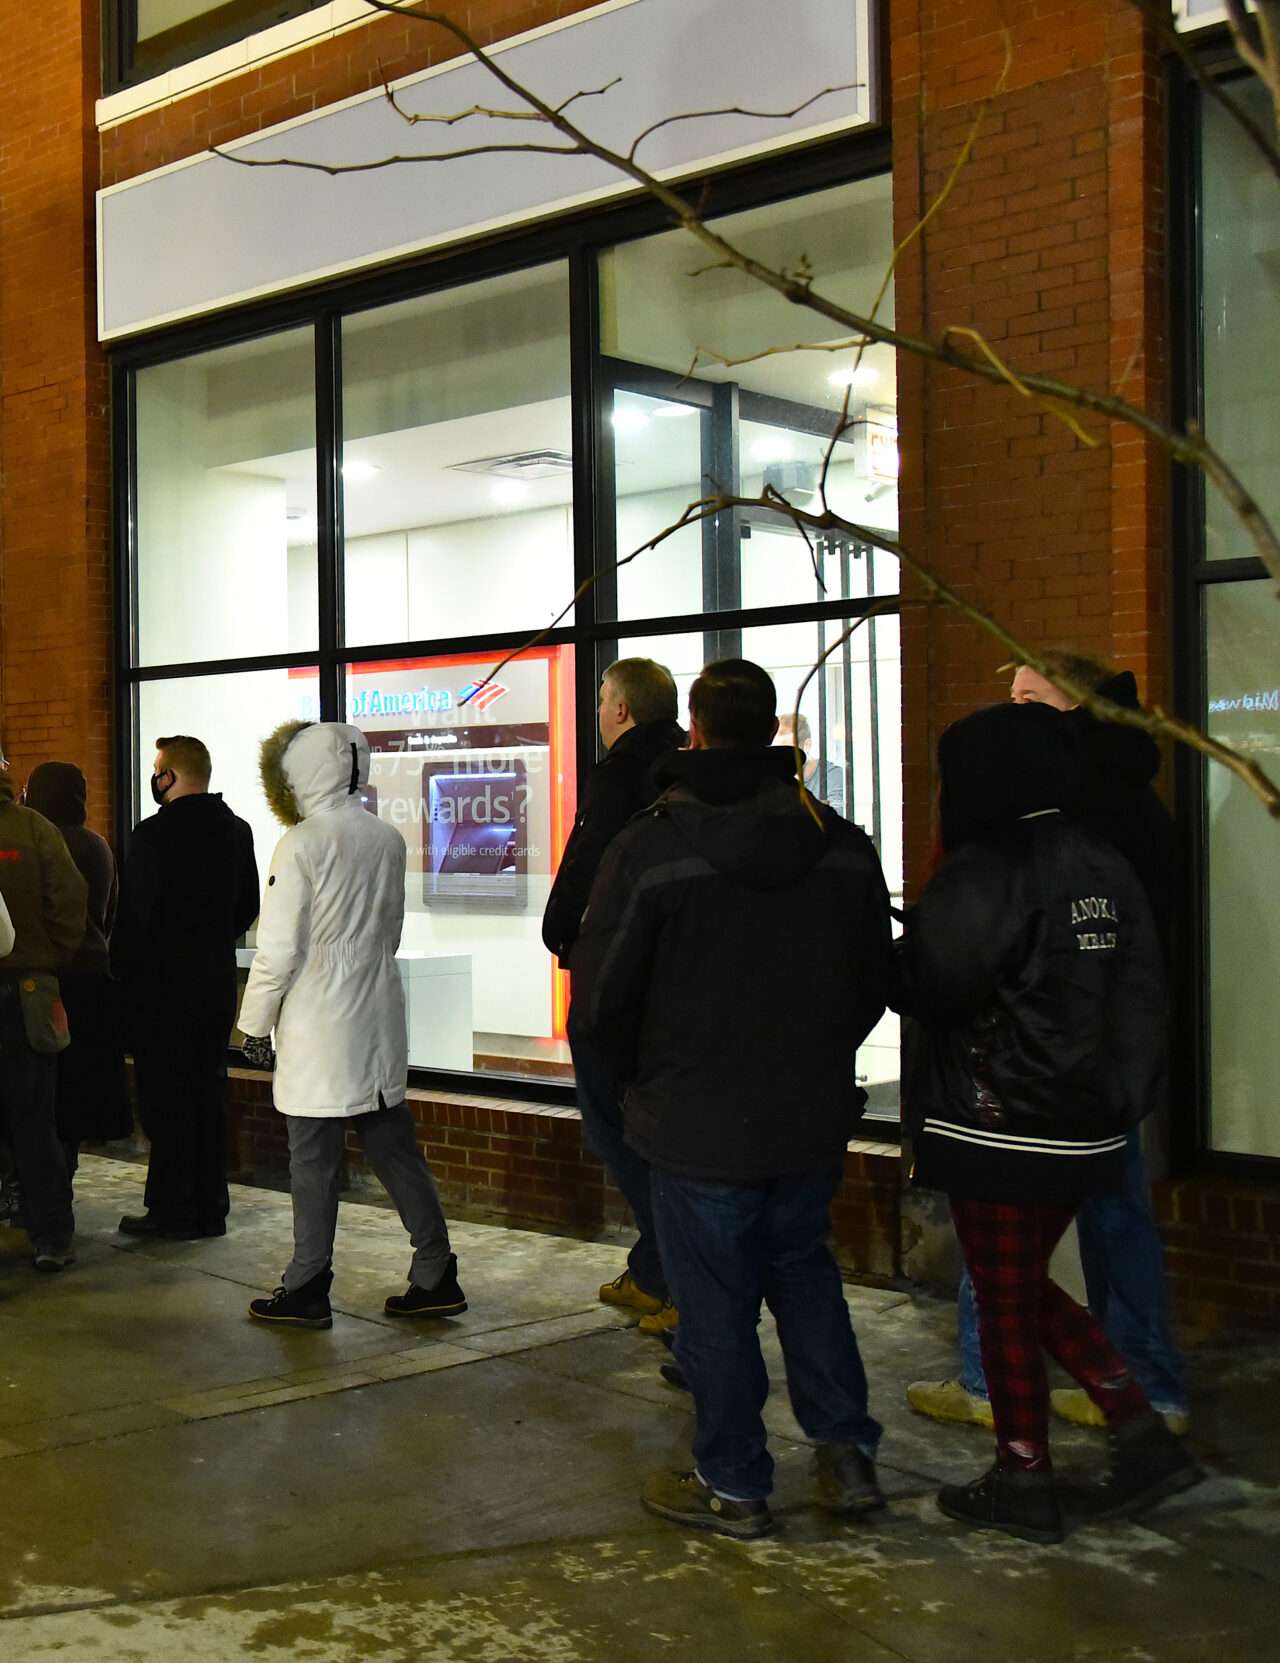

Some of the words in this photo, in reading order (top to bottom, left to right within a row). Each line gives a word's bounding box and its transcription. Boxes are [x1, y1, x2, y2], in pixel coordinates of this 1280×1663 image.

[417, 844, 438, 857] with
[442, 844, 477, 858] eligible
[480, 844, 508, 857] credit
[512, 844, 541, 857] cards
